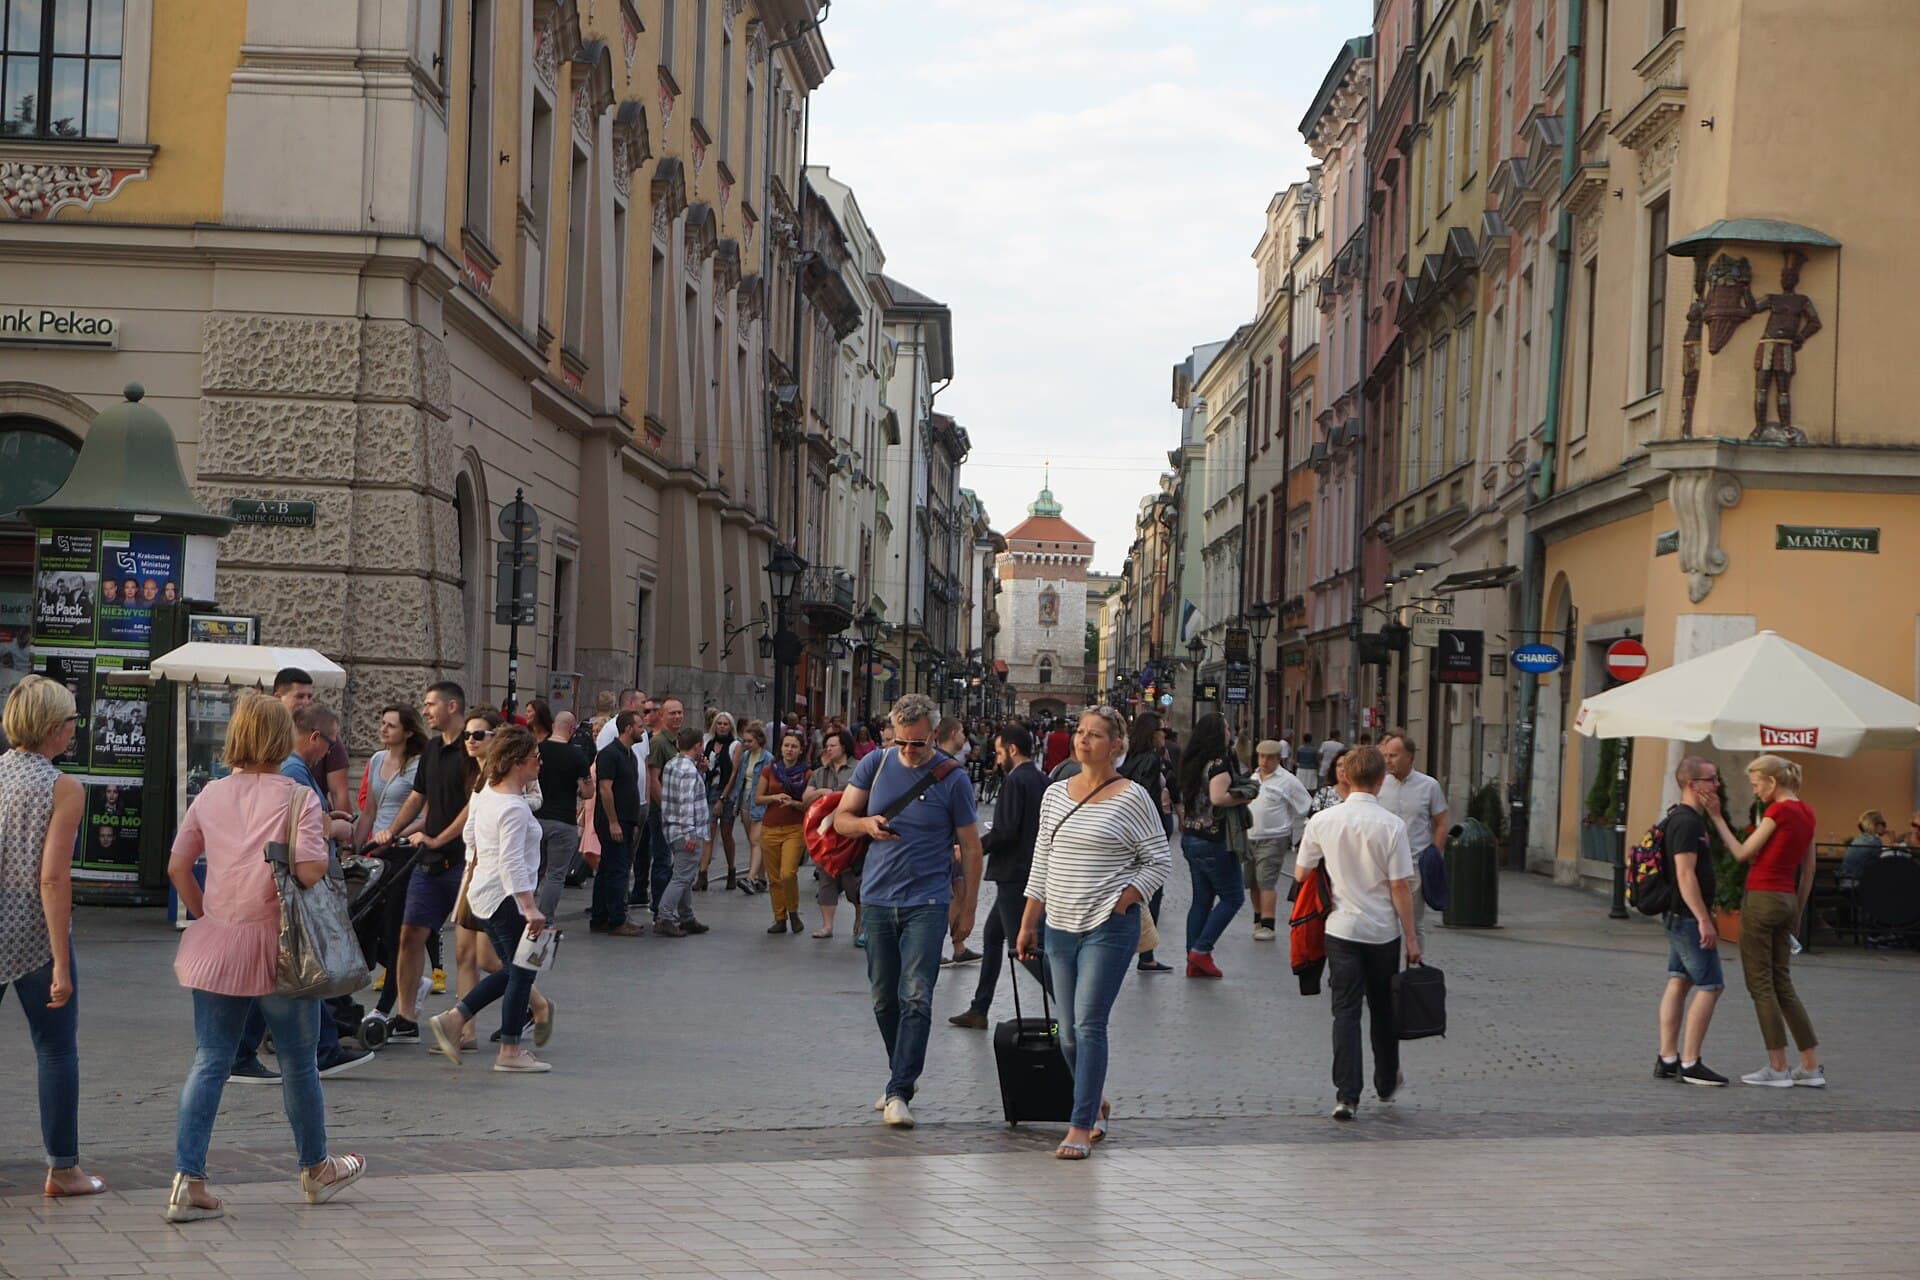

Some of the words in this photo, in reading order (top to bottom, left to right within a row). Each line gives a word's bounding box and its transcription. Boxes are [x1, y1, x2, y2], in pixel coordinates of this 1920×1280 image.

[0, 309, 32, 331] nk
[39, 310, 113, 335] Pekao
[236, 513, 266, 522] RYNEK
[1787, 535, 1870, 550] MARIACKI
[137, 552, 171, 561] Krakowskie
[141, 560, 170, 569] Miniatury
[142, 567, 170, 576] Teatralne
[41, 601, 55, 615] Rat
[56, 600, 83, 616] Pack
[1415, 616, 1454, 625] HOSTEL
[1516, 653, 1559, 664] CHANGE
[105, 731, 128, 745] Rat
[1763, 728, 1815, 745] TYSKIE
[112, 744, 136, 753] Sinatra
[92, 812, 119, 825] BÓG
